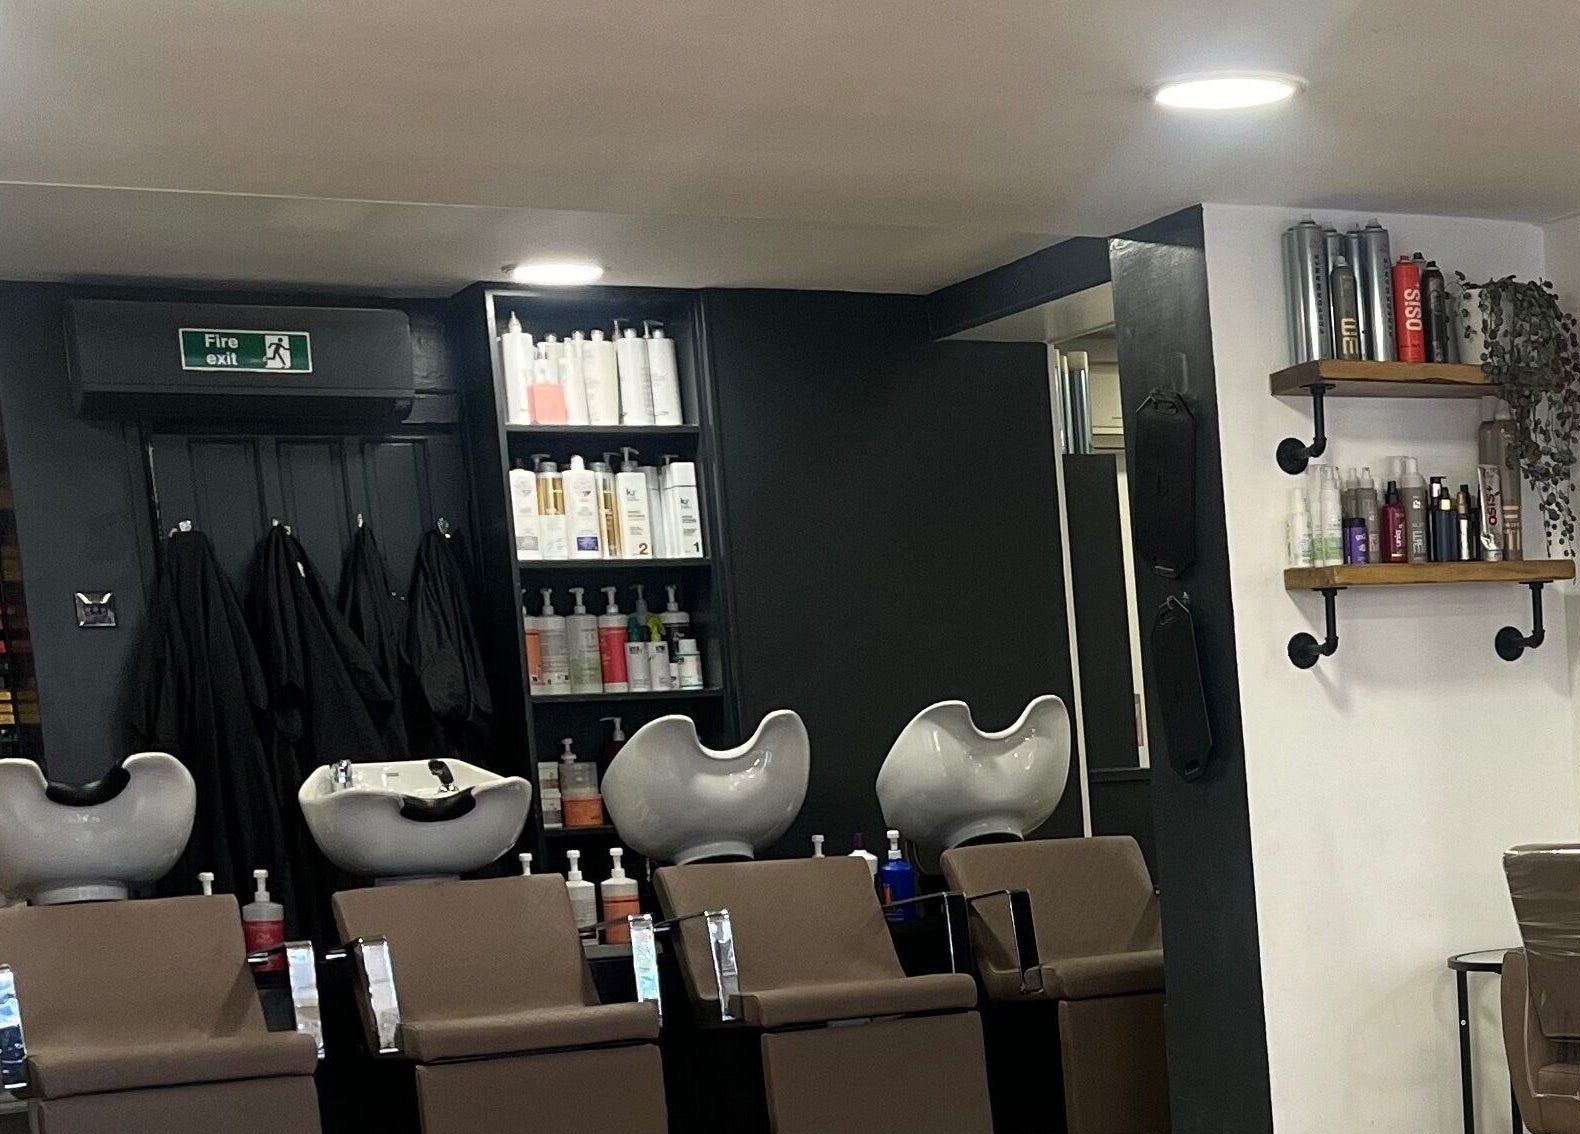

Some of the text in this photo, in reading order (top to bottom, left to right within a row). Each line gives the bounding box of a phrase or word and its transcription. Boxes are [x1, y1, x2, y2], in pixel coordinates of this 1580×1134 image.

[204, 333, 239, 348] Fire
[206, 352, 239, 366] exit
[638, 542, 649, 556] 2
[693, 541, 700, 553] 1
